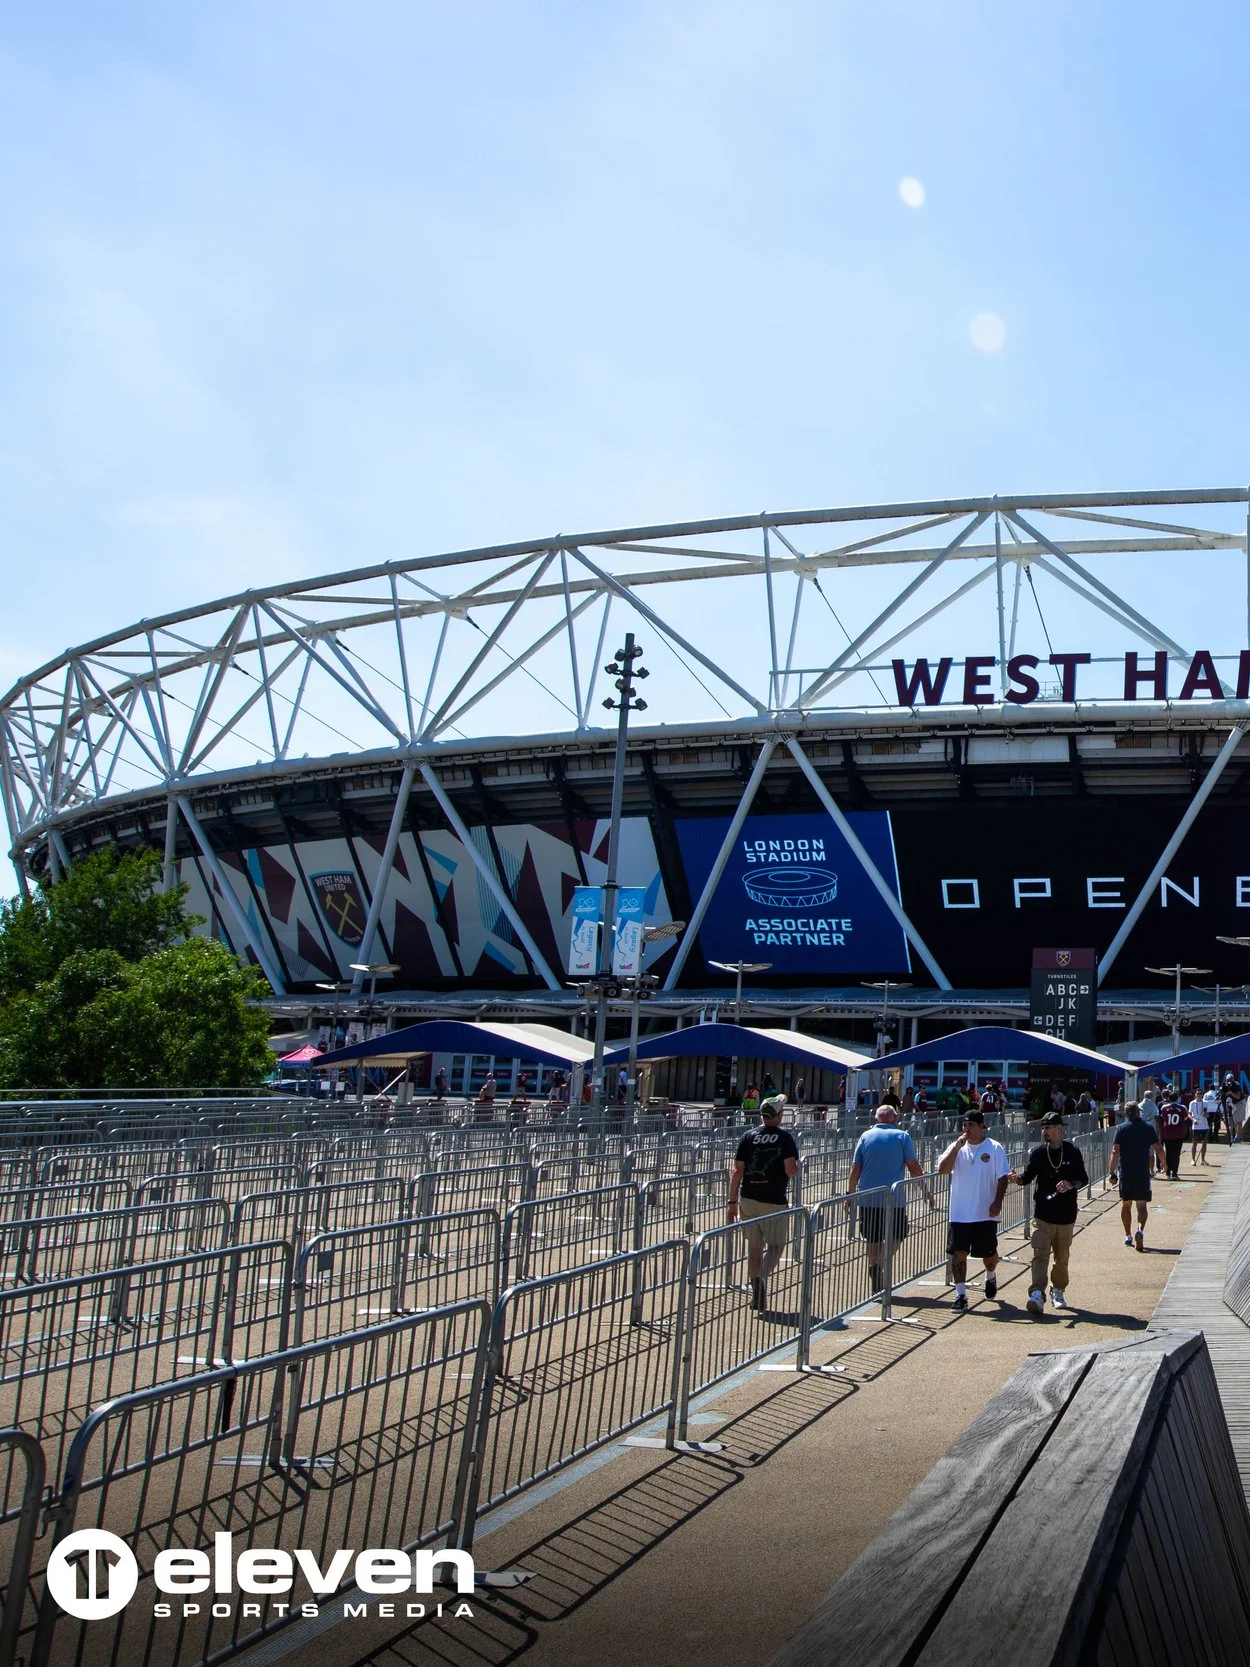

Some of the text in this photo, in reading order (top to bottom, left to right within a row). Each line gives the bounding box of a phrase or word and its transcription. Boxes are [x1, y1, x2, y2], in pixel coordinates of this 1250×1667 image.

[892, 652, 1091, 707] WEST
[743, 839, 825, 852] LONDON
[746, 851, 826, 863] STADIUM
[315, 875, 352, 887] WEST HAM
[324, 884, 346, 892] UNITED
[745, 918, 853, 931] ASSOCIATE
[586, 926, 596, 952] Legacy
[629, 927, 639, 953] Legacy
[753, 932, 846, 946] PARTNER
[1167, 1113, 1180, 1126] 10
[752, 1133, 779, 1145] 500
